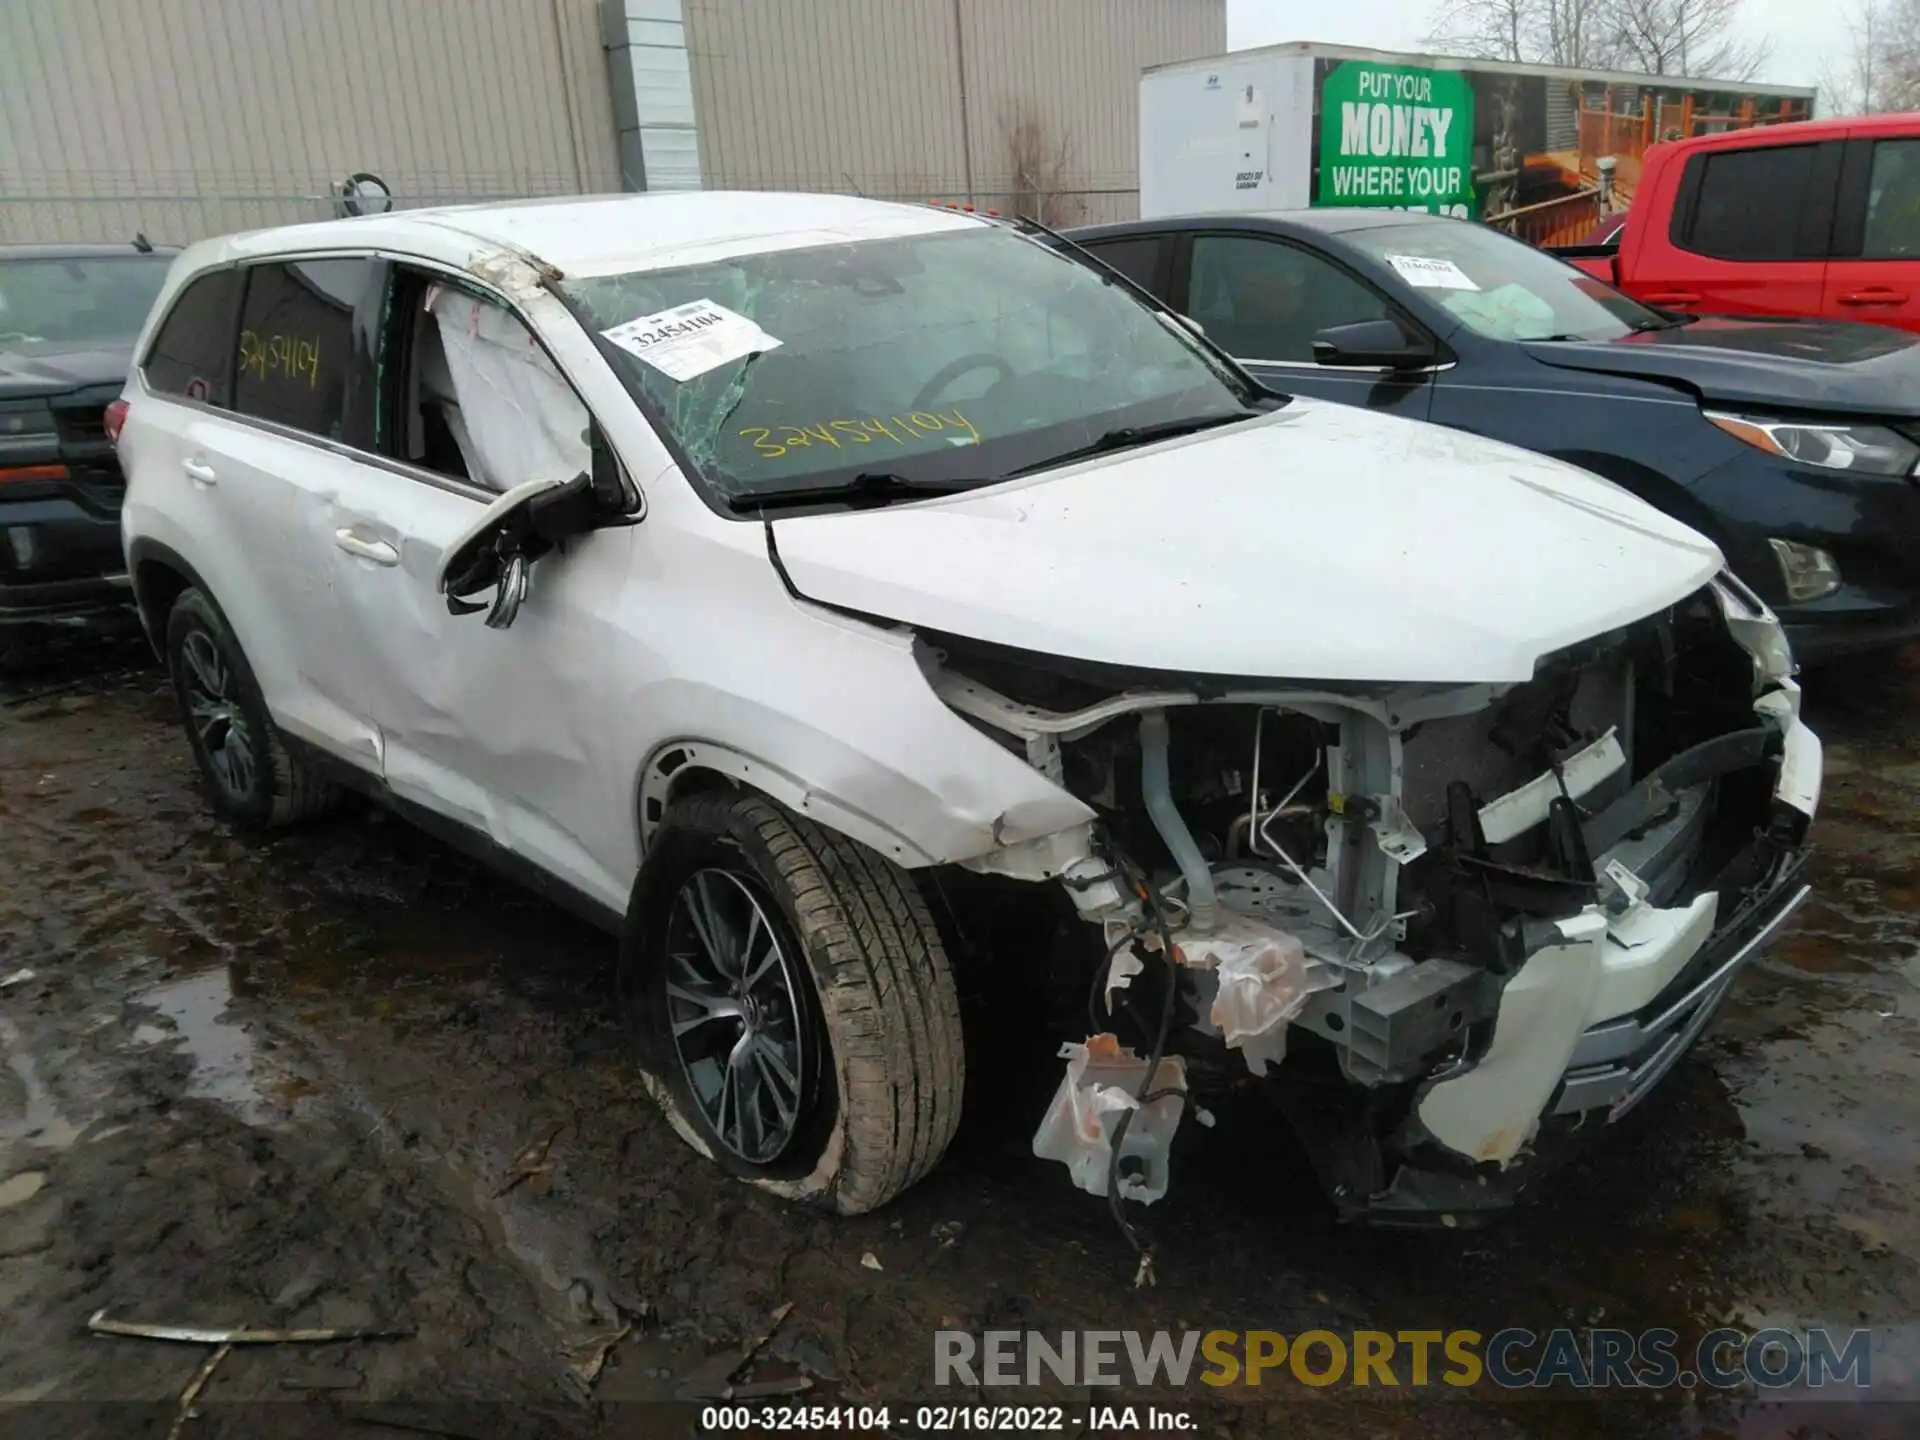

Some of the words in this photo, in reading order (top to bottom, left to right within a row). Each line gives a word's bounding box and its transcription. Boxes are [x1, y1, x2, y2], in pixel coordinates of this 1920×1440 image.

[1359, 71, 1392, 97] PUT
[1393, 74, 1432, 102] YOUR
[1340, 101, 1453, 158] MONEY
[1332, 166, 1404, 196] WHERE
[1407, 166, 1461, 195] YOUR
[632, 311, 724, 348] 32454104
[739, 409, 980, 458] 32454104
